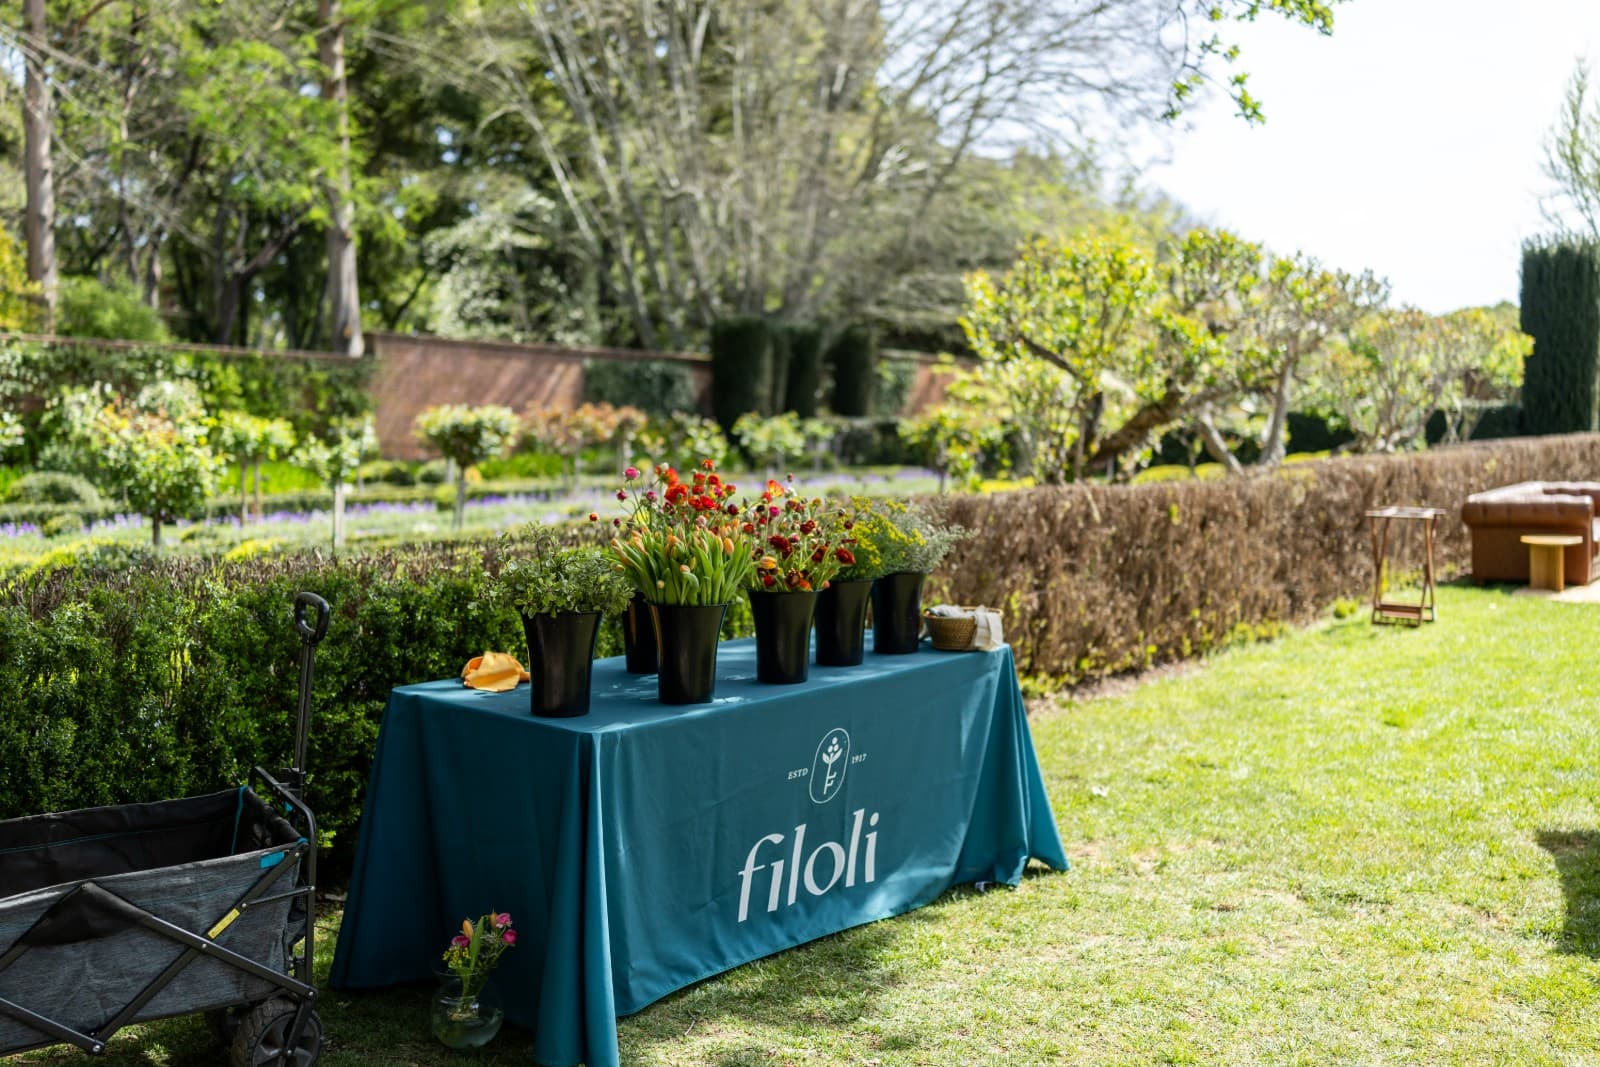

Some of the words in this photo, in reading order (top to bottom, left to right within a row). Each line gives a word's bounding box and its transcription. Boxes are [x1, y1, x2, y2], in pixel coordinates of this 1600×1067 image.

[788, 768, 808, 780] ESTD
[851, 753, 867, 764] 1917
[738, 808, 879, 922] filoli
